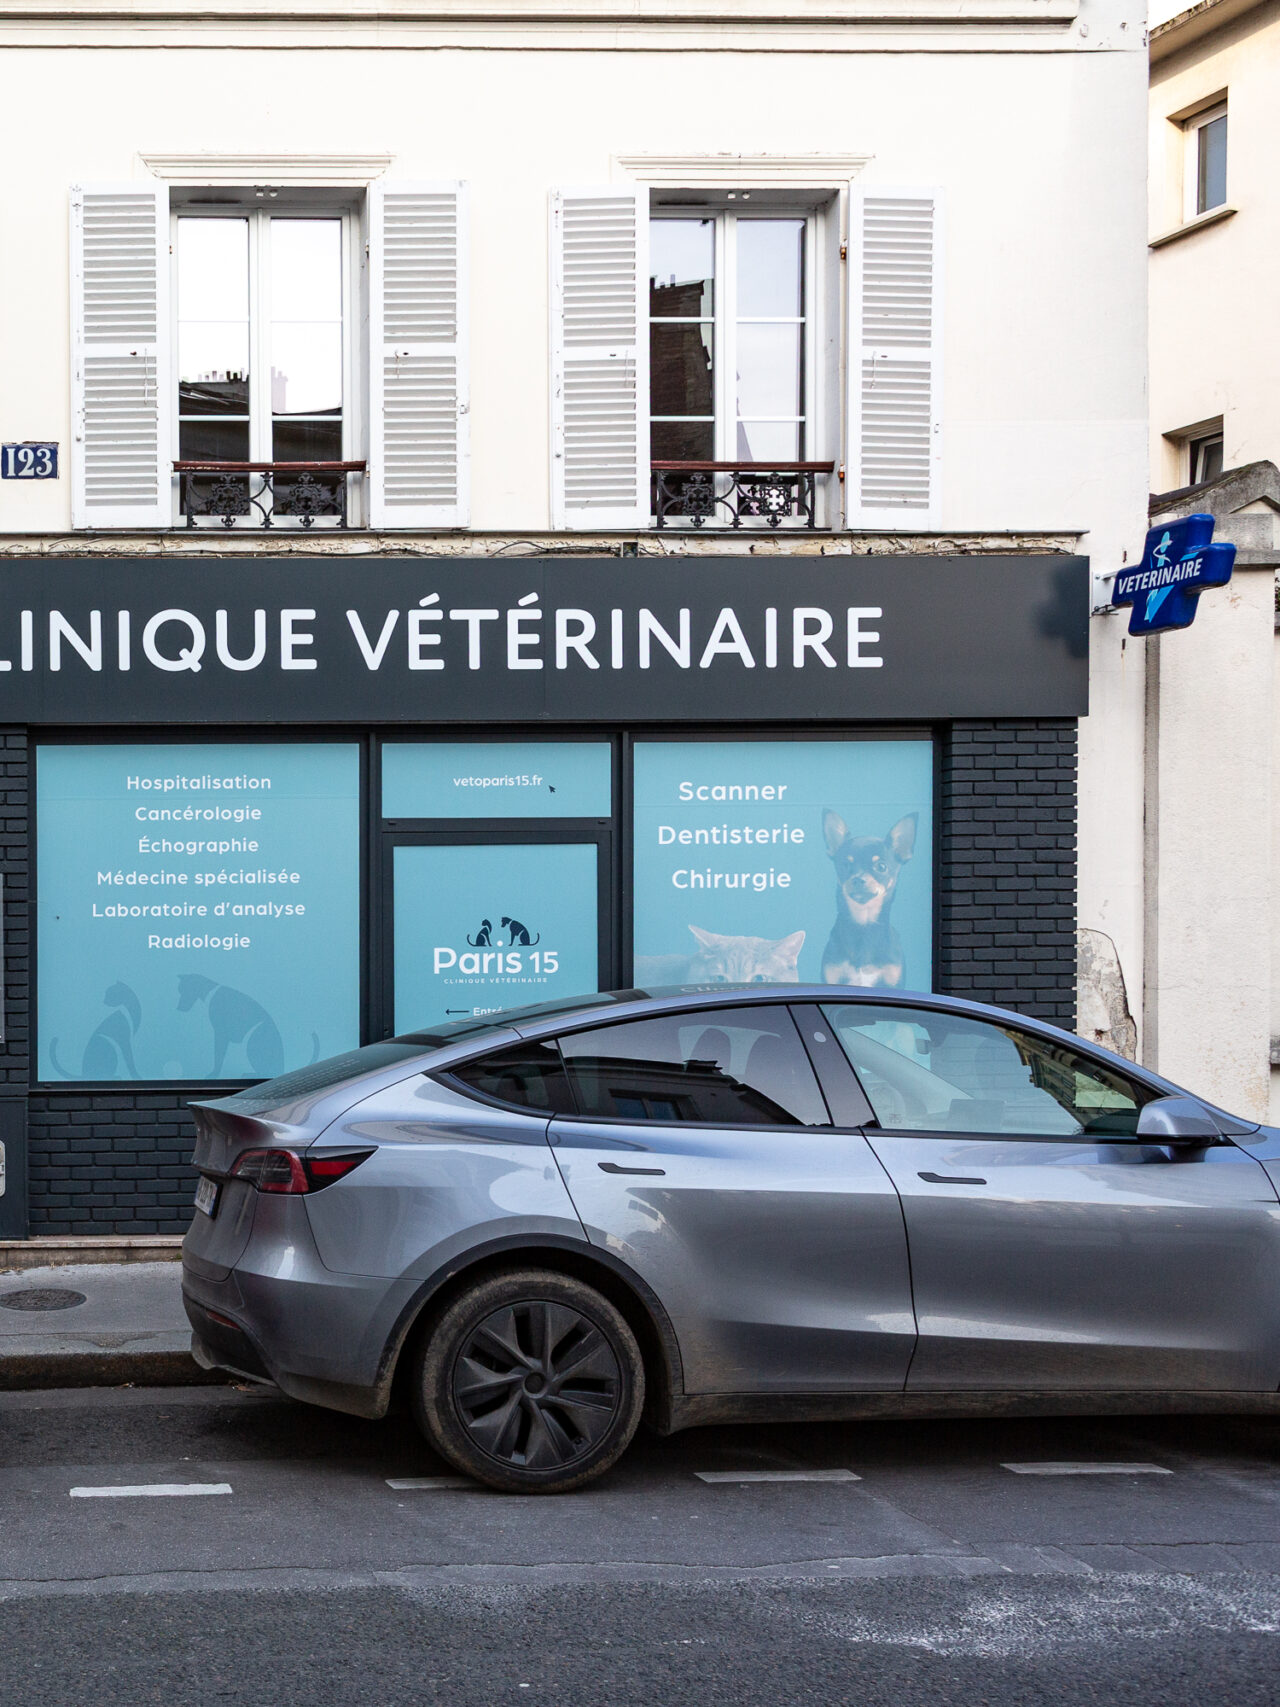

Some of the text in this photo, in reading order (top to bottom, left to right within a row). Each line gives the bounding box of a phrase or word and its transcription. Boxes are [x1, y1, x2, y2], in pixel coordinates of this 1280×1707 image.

[6, 448, 52, 476] 123
[1118, 558, 1203, 595] VETERINAIRE
[347, 592, 885, 671] VÉTÉRINAIRE
[126, 776, 271, 792] Hospitalisation
[454, 775, 543, 788] vetoparis15.fr
[678, 782, 788, 801] Scanner
[135, 806, 262, 823] Cancérologie
[658, 824, 805, 845] Dentisterie
[138, 836, 260, 854] Échographie
[97, 869, 301, 887] Médecine spécialisée
[672, 868, 792, 892] Chirurgie
[92, 902, 306, 919] Laboratoire d'analyse
[148, 934, 251, 950] Radiologie
[433, 940, 559, 974] Paris 15
[473, 1006, 503, 1016] Entr
